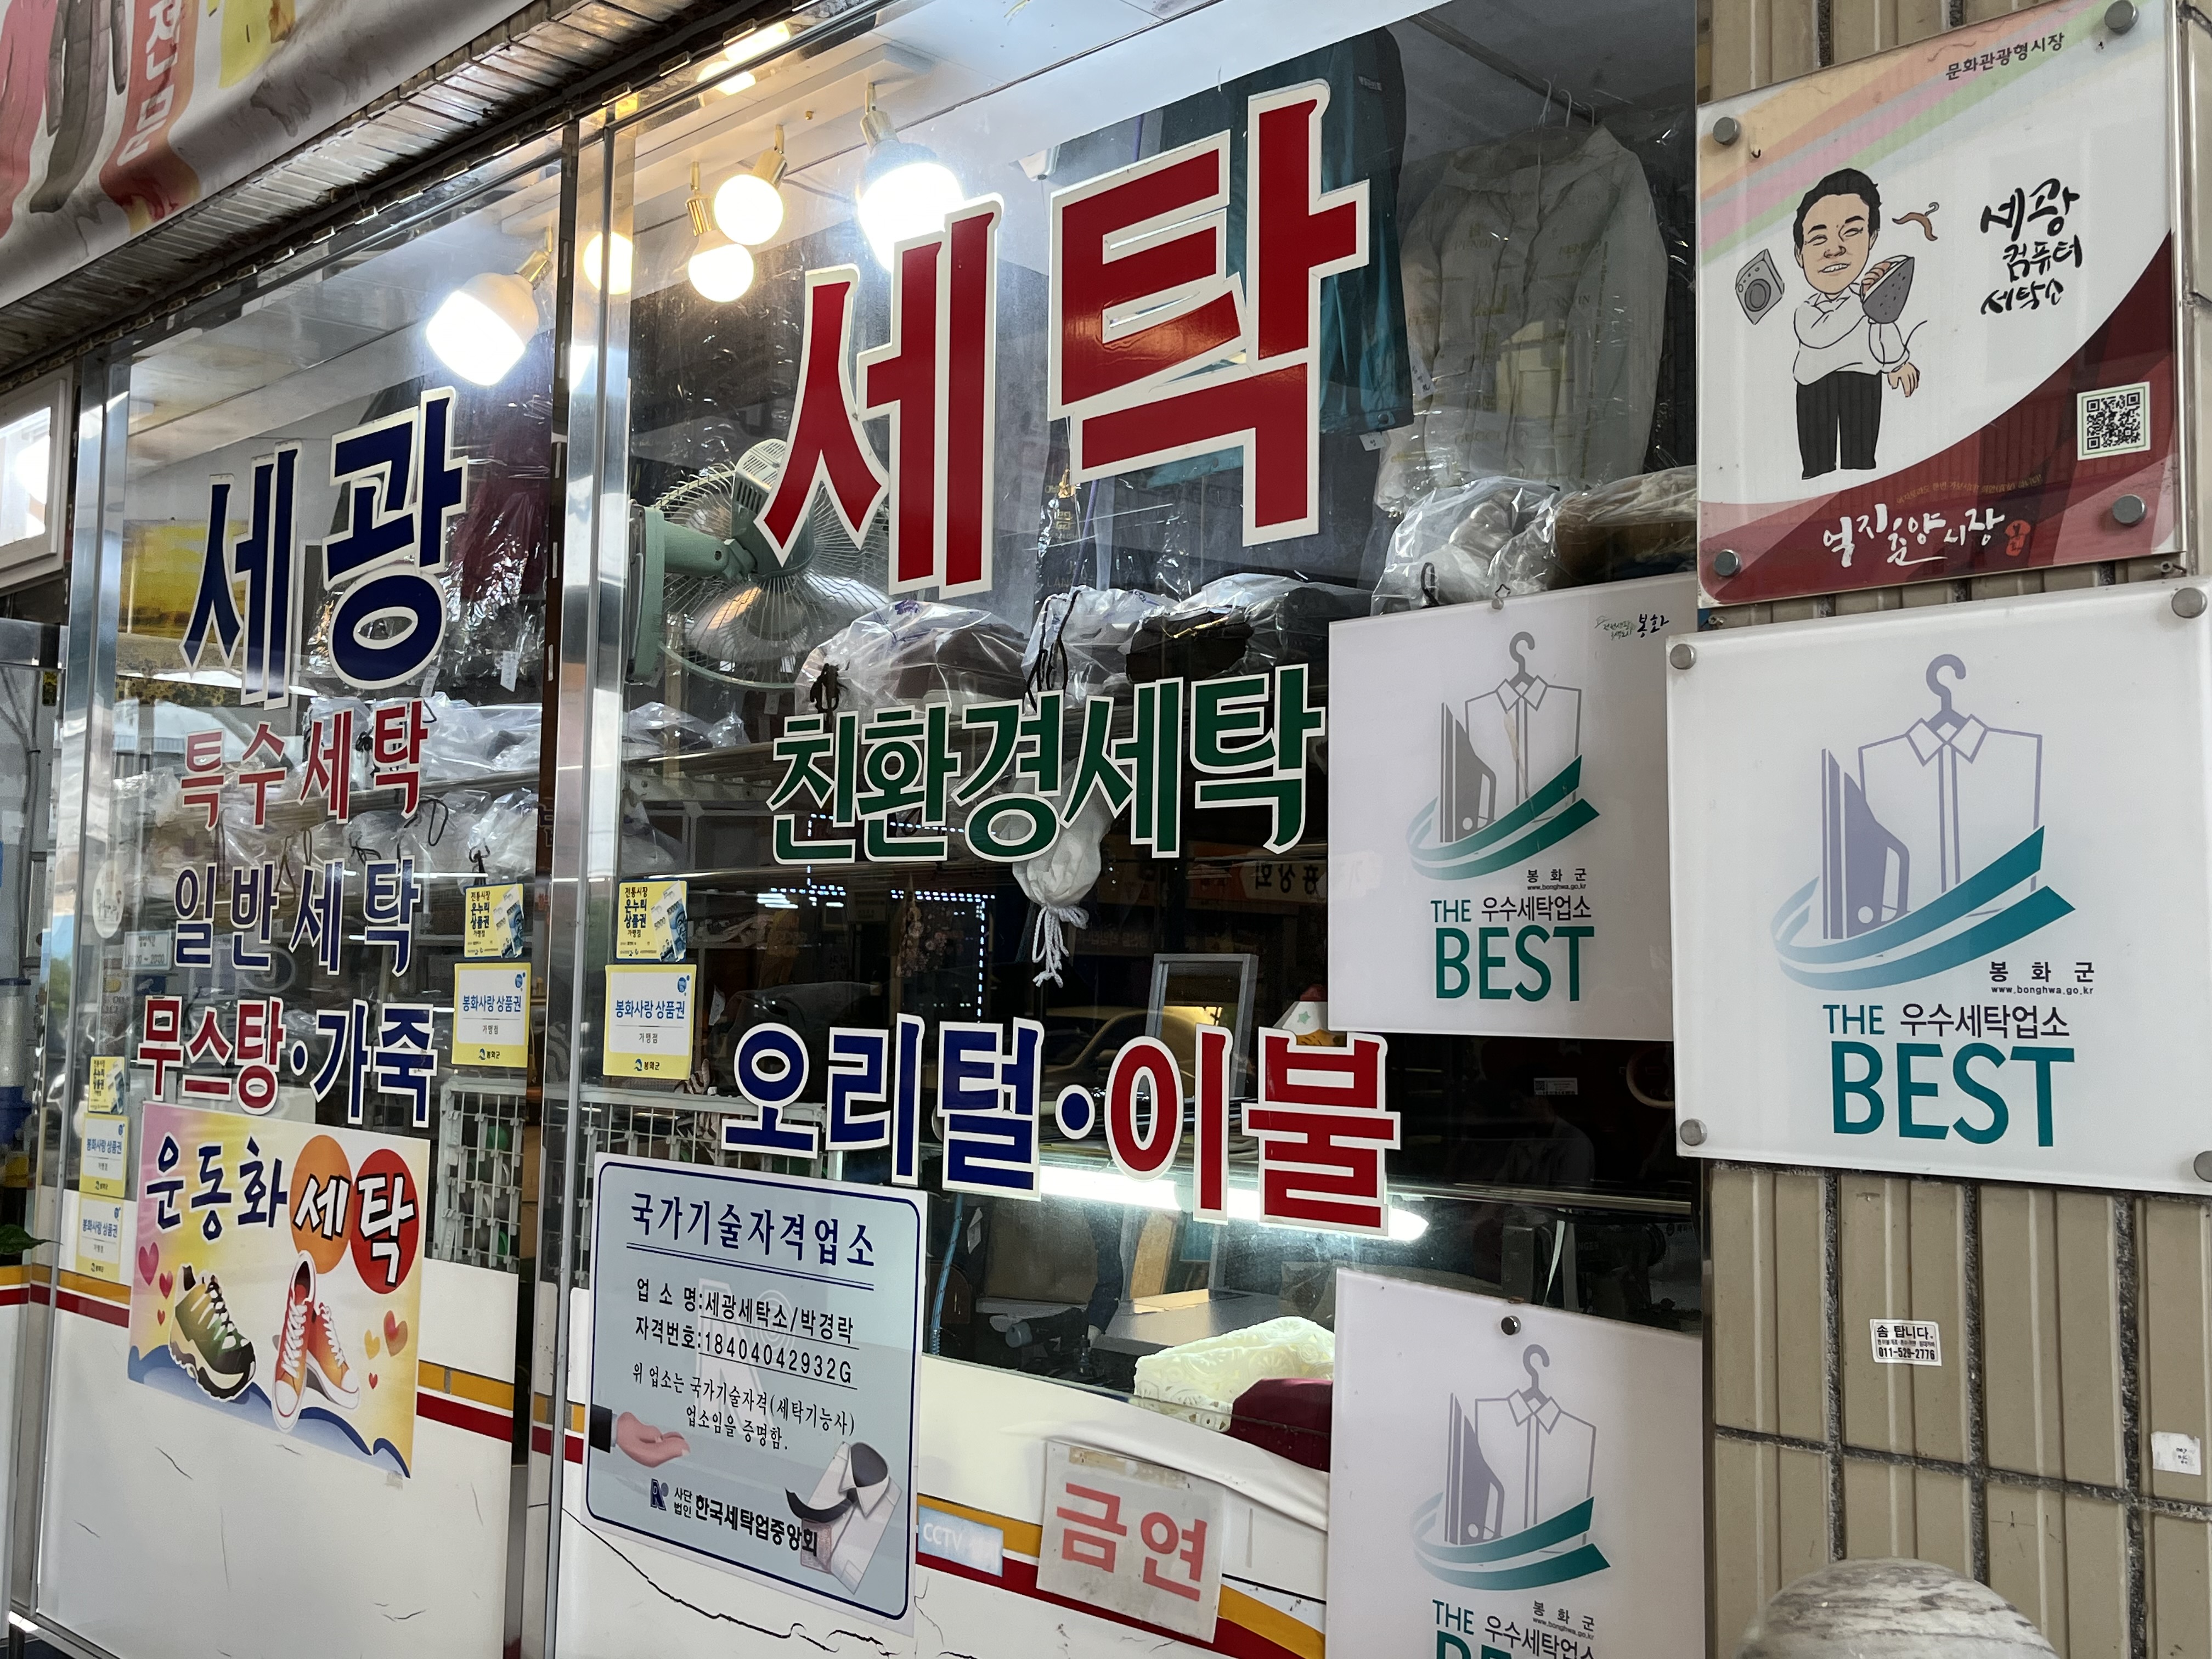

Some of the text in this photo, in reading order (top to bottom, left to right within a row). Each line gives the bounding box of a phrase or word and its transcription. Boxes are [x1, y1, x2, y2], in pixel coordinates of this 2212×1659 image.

[1946, 32, 2066, 80] 문화관광형시장
[1980, 178, 2080, 241] 세광
[2002, 235, 2083, 283] 컴퓨터
[1980, 279, 2066, 316] 세탁소
[753, 78, 1369, 599] 세탁
[179, 386, 468, 710] 세광
[1637, 613, 1670, 639] 봉화
[180, 697, 430, 832] 특수세탁
[766, 663, 1326, 864] 친환경세탁
[173, 855, 422, 977] 일반세탁
[1430, 899, 1472, 923] THE
[1481, 895, 1592, 922] 우수세탁업소
[1435, 924, 1595, 1002] BEST
[462, 995, 522, 1013] 봉화사랑 상품권
[615, 1000, 685, 1020] 봉화사랑 상품권
[1990, 985, 2094, 995] www.bonghwa.go.kr
[1822, 1005, 1886, 1036] THE
[1900, 1003, 2070, 1039] 우수세탁업소
[1831, 1041, 2075, 1147] BEST
[145, 1132, 415, 1286] 운동화 세탁
[631, 1192, 874, 1267] 국가기술자격업소
[1877, 1324, 1888, 1338] 솜
[1878, 1347, 1936, 1360] 011-529-2776
[633, 1362, 856, 1437] 위 업소는 국가기술자격(세탁기능사)
[686, 1405, 788, 1450] 업소임을 증명함.
[674, 1487, 692, 1503] 사단
[674, 1502, 691, 1519] 법인
[695, 1494, 818, 1557] 한국세탁업중앙회
[923, 1522, 962, 1551] CCTV
[1056, 1482, 1208, 1602] 금연
[1432, 1599, 1475, 1636] THE
